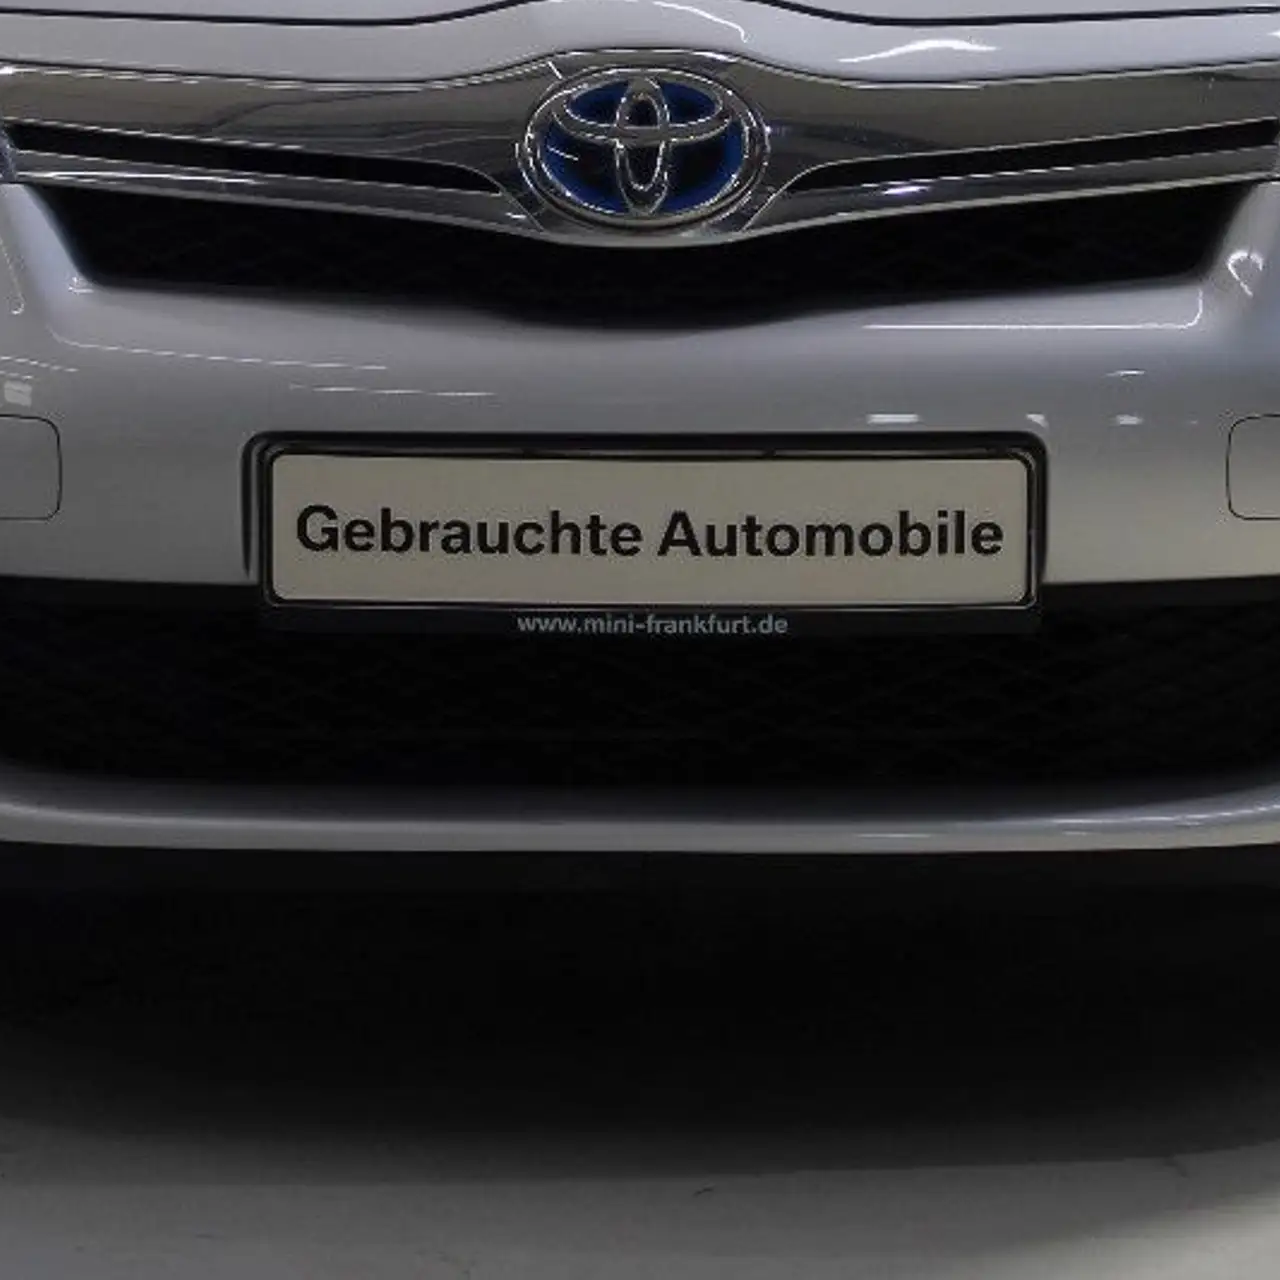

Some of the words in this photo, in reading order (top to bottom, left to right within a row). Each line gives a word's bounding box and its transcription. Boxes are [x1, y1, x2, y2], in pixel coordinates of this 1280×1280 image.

[296, 504, 643, 557] Gebrauchte
[657, 509, 1004, 557] Automobile
[517, 614, 789, 635] www.mini-frankfurt.de
